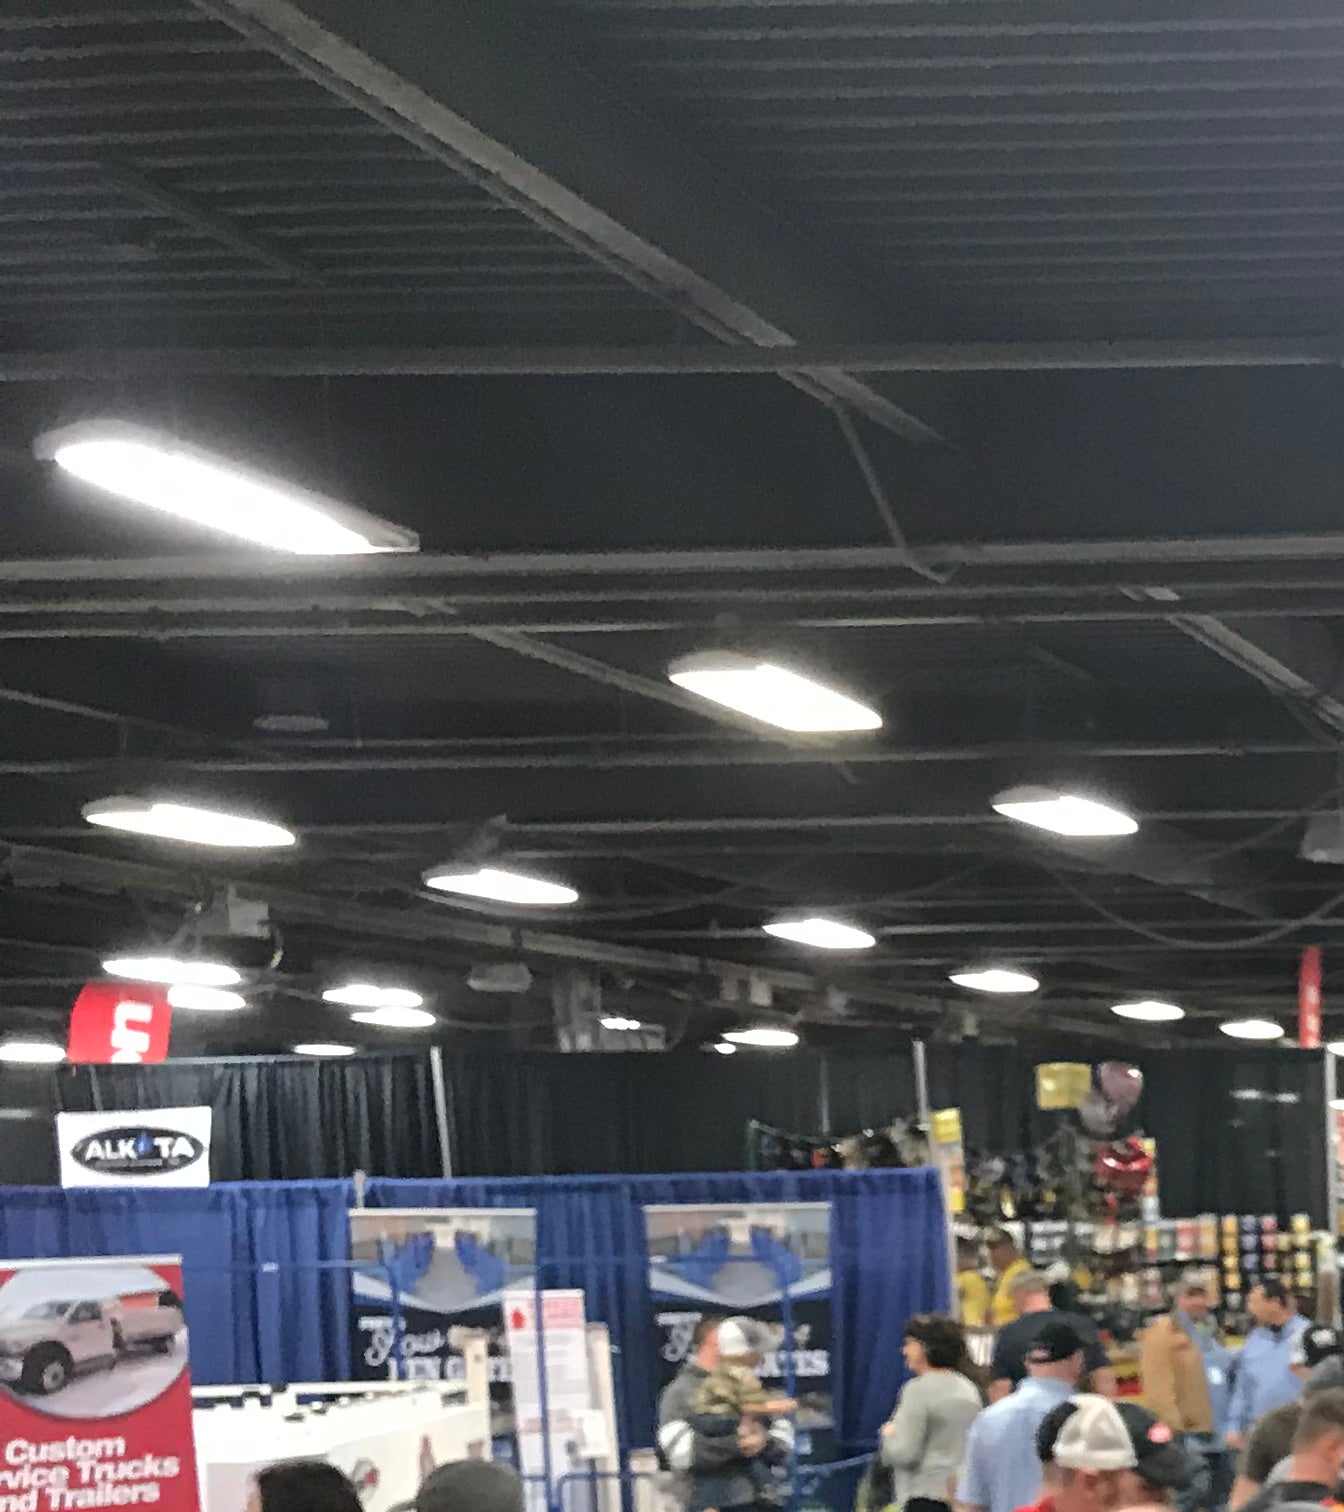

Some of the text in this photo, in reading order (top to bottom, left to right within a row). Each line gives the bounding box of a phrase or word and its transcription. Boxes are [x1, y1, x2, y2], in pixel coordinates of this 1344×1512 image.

[5, 1436, 126, 1466] Custom
[77, 1454, 181, 1484] Trucks
[46, 1482, 160, 1511] Trailers
